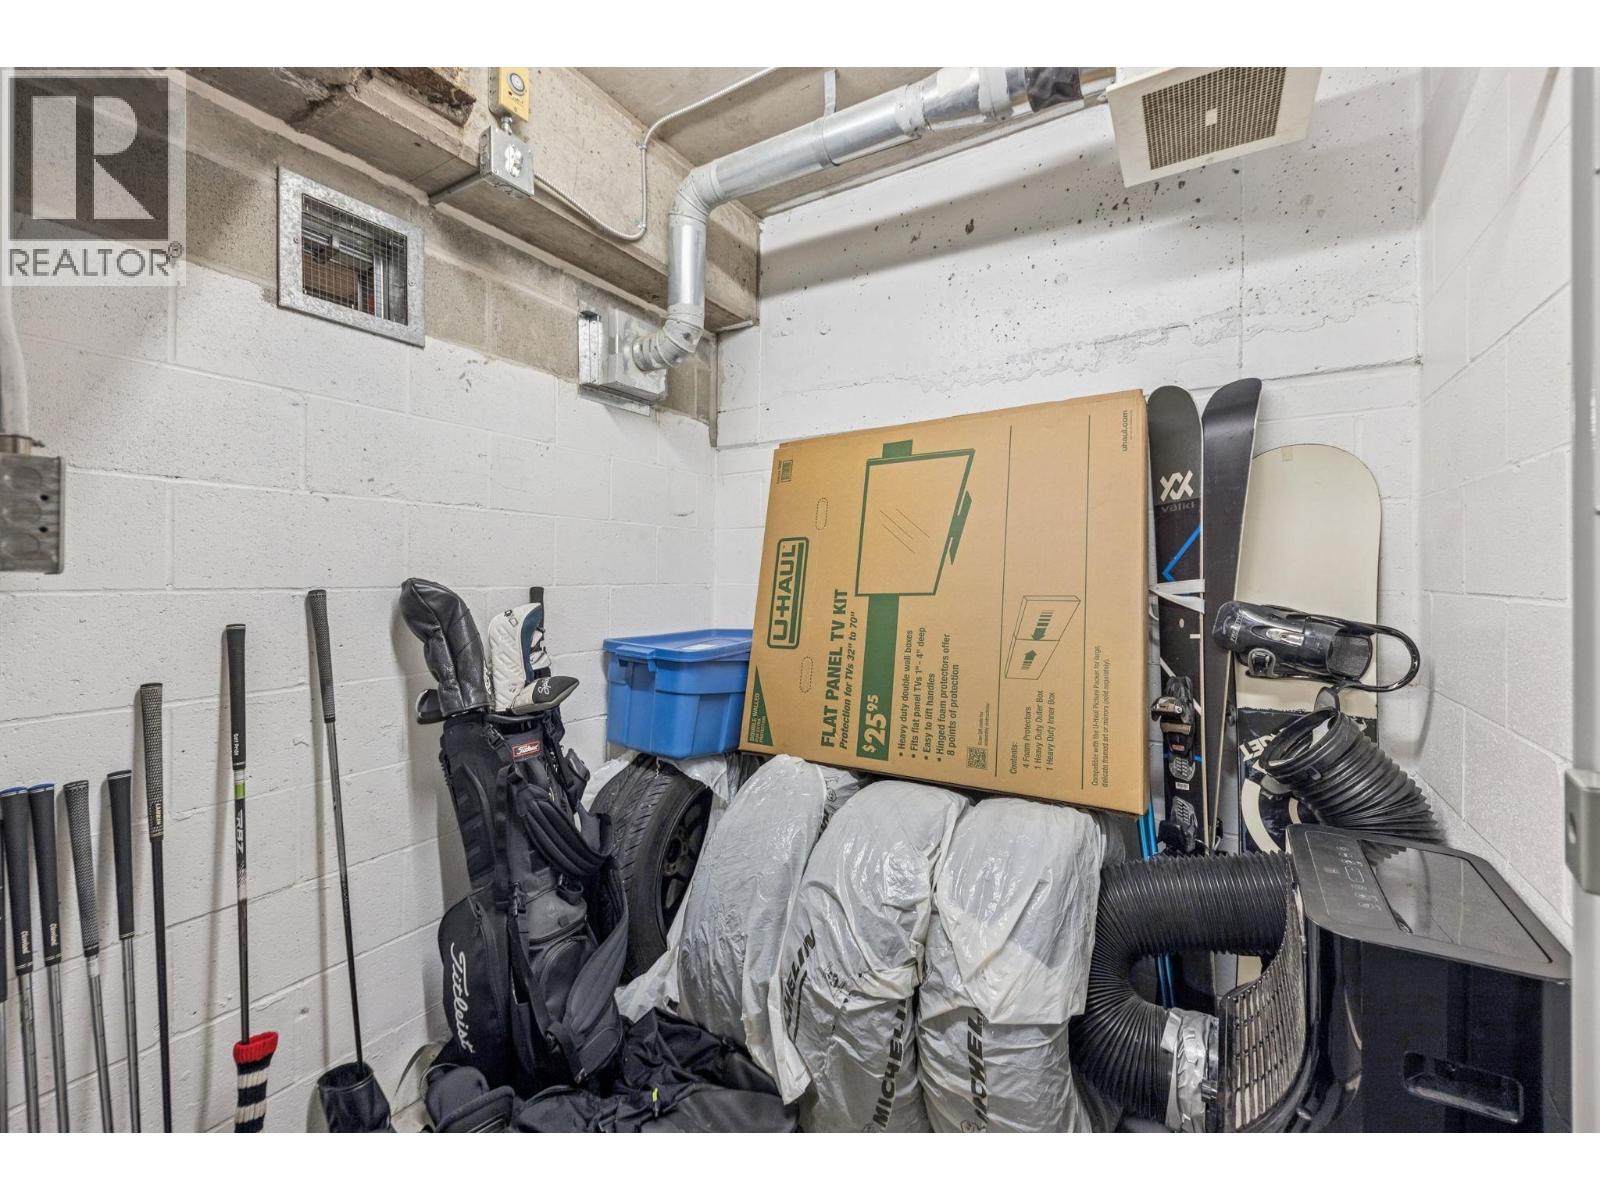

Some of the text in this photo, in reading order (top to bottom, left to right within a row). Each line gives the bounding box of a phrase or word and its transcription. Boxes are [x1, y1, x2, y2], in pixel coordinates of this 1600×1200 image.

[848, 631, 856, 640] to
[916, 627, 927, 647] deep
[820, 589, 848, 748] FLAT PANEL TV KIT
[845, 663, 854, 680] TVs
[844, 682, 852, 697] for
[898, 630, 913, 750] Heavy duty double wall boxes
[914, 676, 922, 692] TVs
[936, 633, 951, 755] Hinged foam protectors offer
[950, 664, 960, 708] protection
[752, 692, 760, 716] WALLED
[912, 694, 922, 718] panel
[1036, 690, 1044, 703] Box
[1048, 692, 1056, 705] Box
[923, 672, 936, 753] Easy to lift handles
[949, 710, 957, 719] of
[1035, 705, 1044, 723] Outer
[1047, 706, 1055, 724] Inner
[839, 697, 852, 750] Protection
[911, 719, 920, 734] flat
[948, 720, 958, 748] points
[1023, 706, 1032, 741] Protectors
[1034, 724, 1044, 740] Duty
[1046, 726, 1056, 742] Duty
[910, 736, 919, 752] Fits
[1022, 743, 1031, 762] Foam
[1034, 742, 1044, 764] Heavy
[1010, 742, 1018, 774] Contents:
[1046, 744, 1055, 766] Heavy
[450, 942, 476, 1054] Titleist
[872, 1000, 906, 1129] MICHELI
